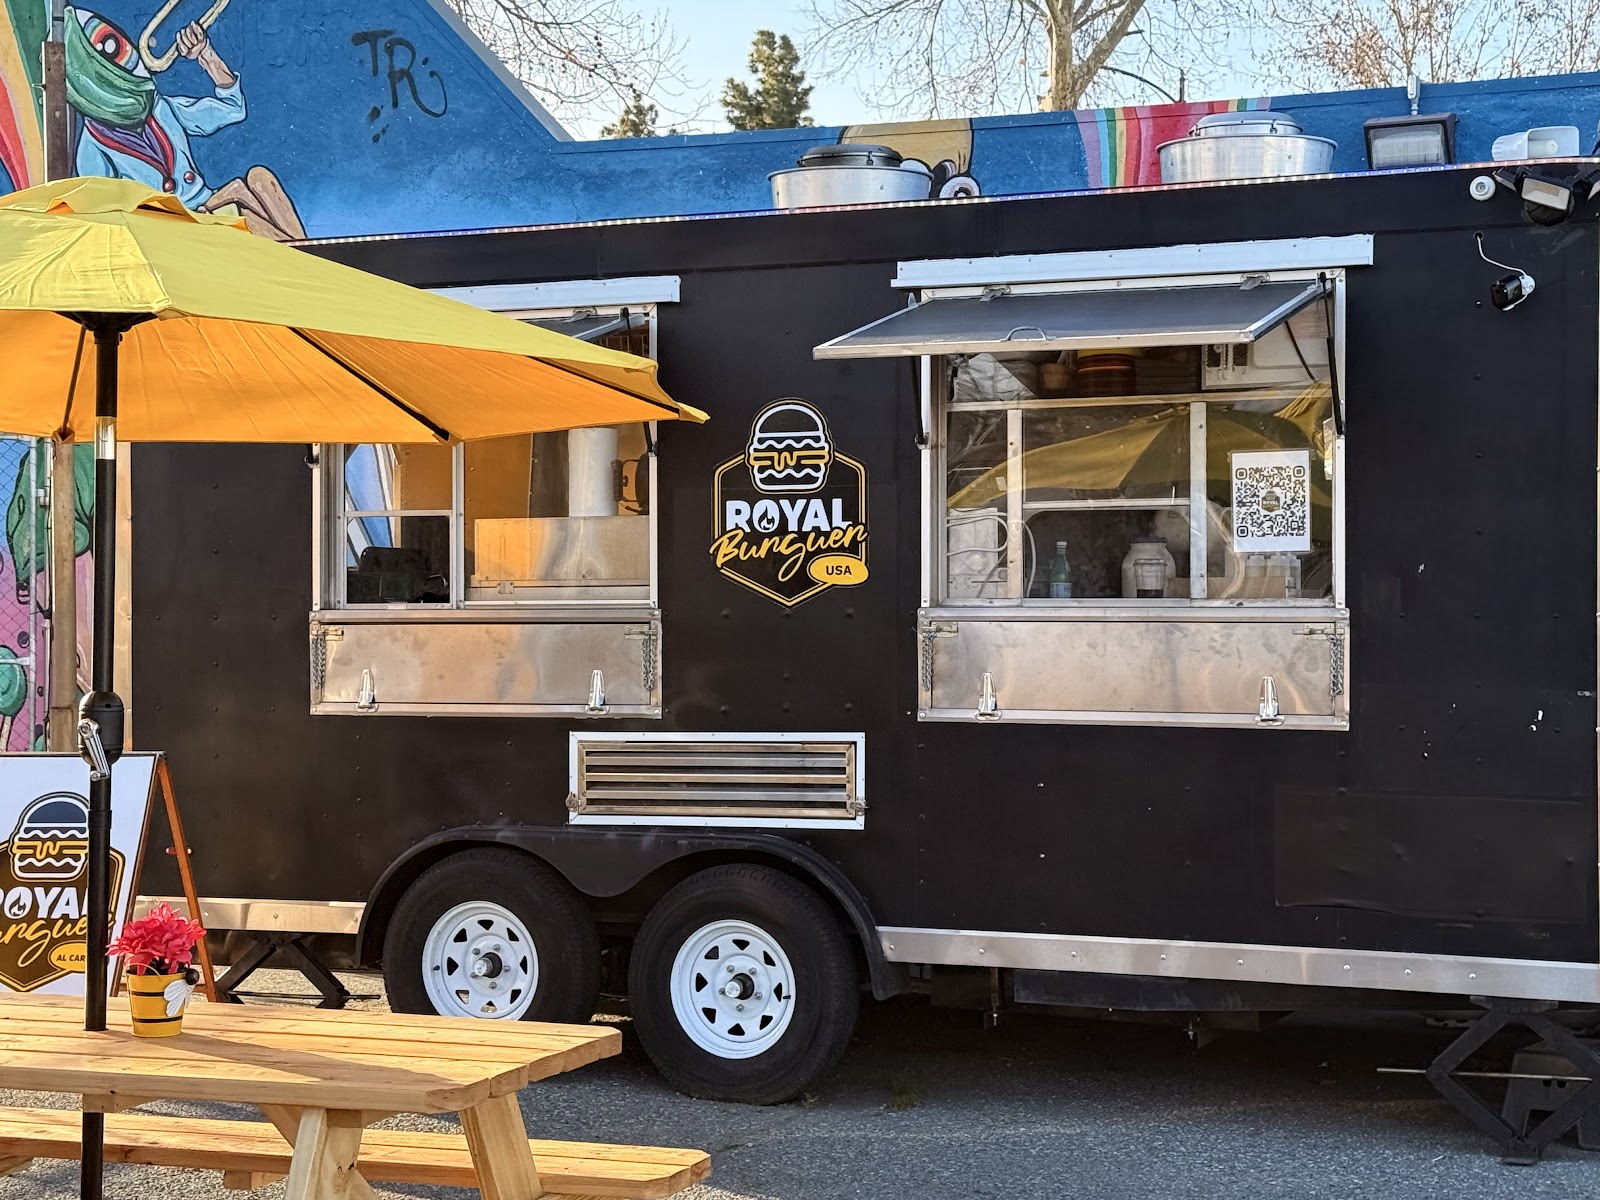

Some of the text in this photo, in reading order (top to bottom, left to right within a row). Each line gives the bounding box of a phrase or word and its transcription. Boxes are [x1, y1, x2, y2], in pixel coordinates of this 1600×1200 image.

[726, 498, 852, 532] ROYAL
[710, 525, 868, 581] Burguer
[826, 565, 852, 576] USA
[0, 886, 88, 919] OYA
[0, 913, 115, 967] rgue
[56, 954, 85, 962] AL CAR
